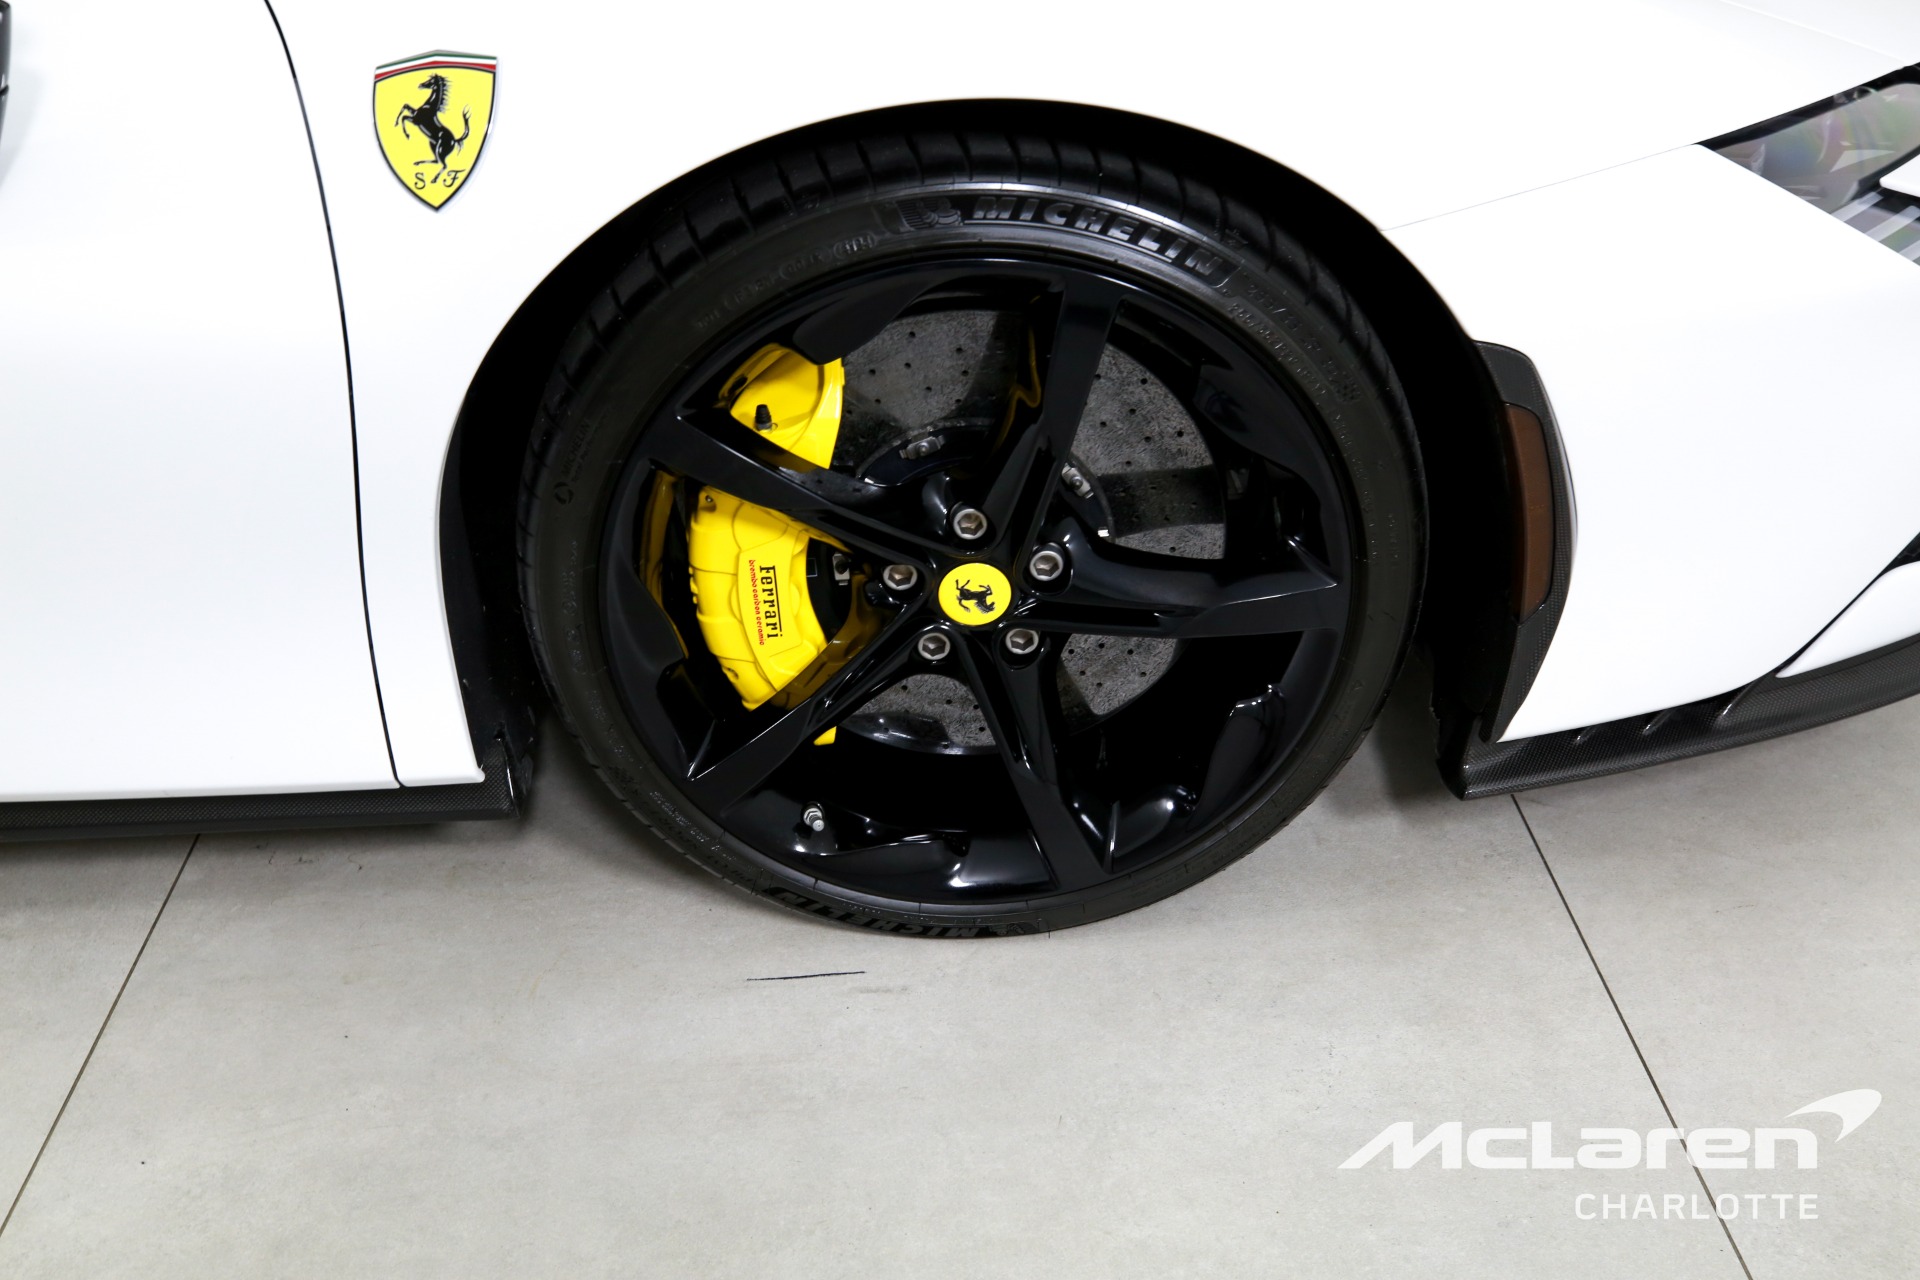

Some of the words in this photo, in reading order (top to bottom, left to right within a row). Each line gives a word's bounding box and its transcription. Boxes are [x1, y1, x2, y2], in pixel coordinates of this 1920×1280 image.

[414, 172, 426, 189] S
[443, 169, 465, 187] F
[972, 196, 1224, 276] MICHELIN
[749, 560, 758, 587] brembo
[753, 588, 761, 615] carbon
[760, 565, 782, 637] Ferrari
[756, 616, 765, 646] ceramic
